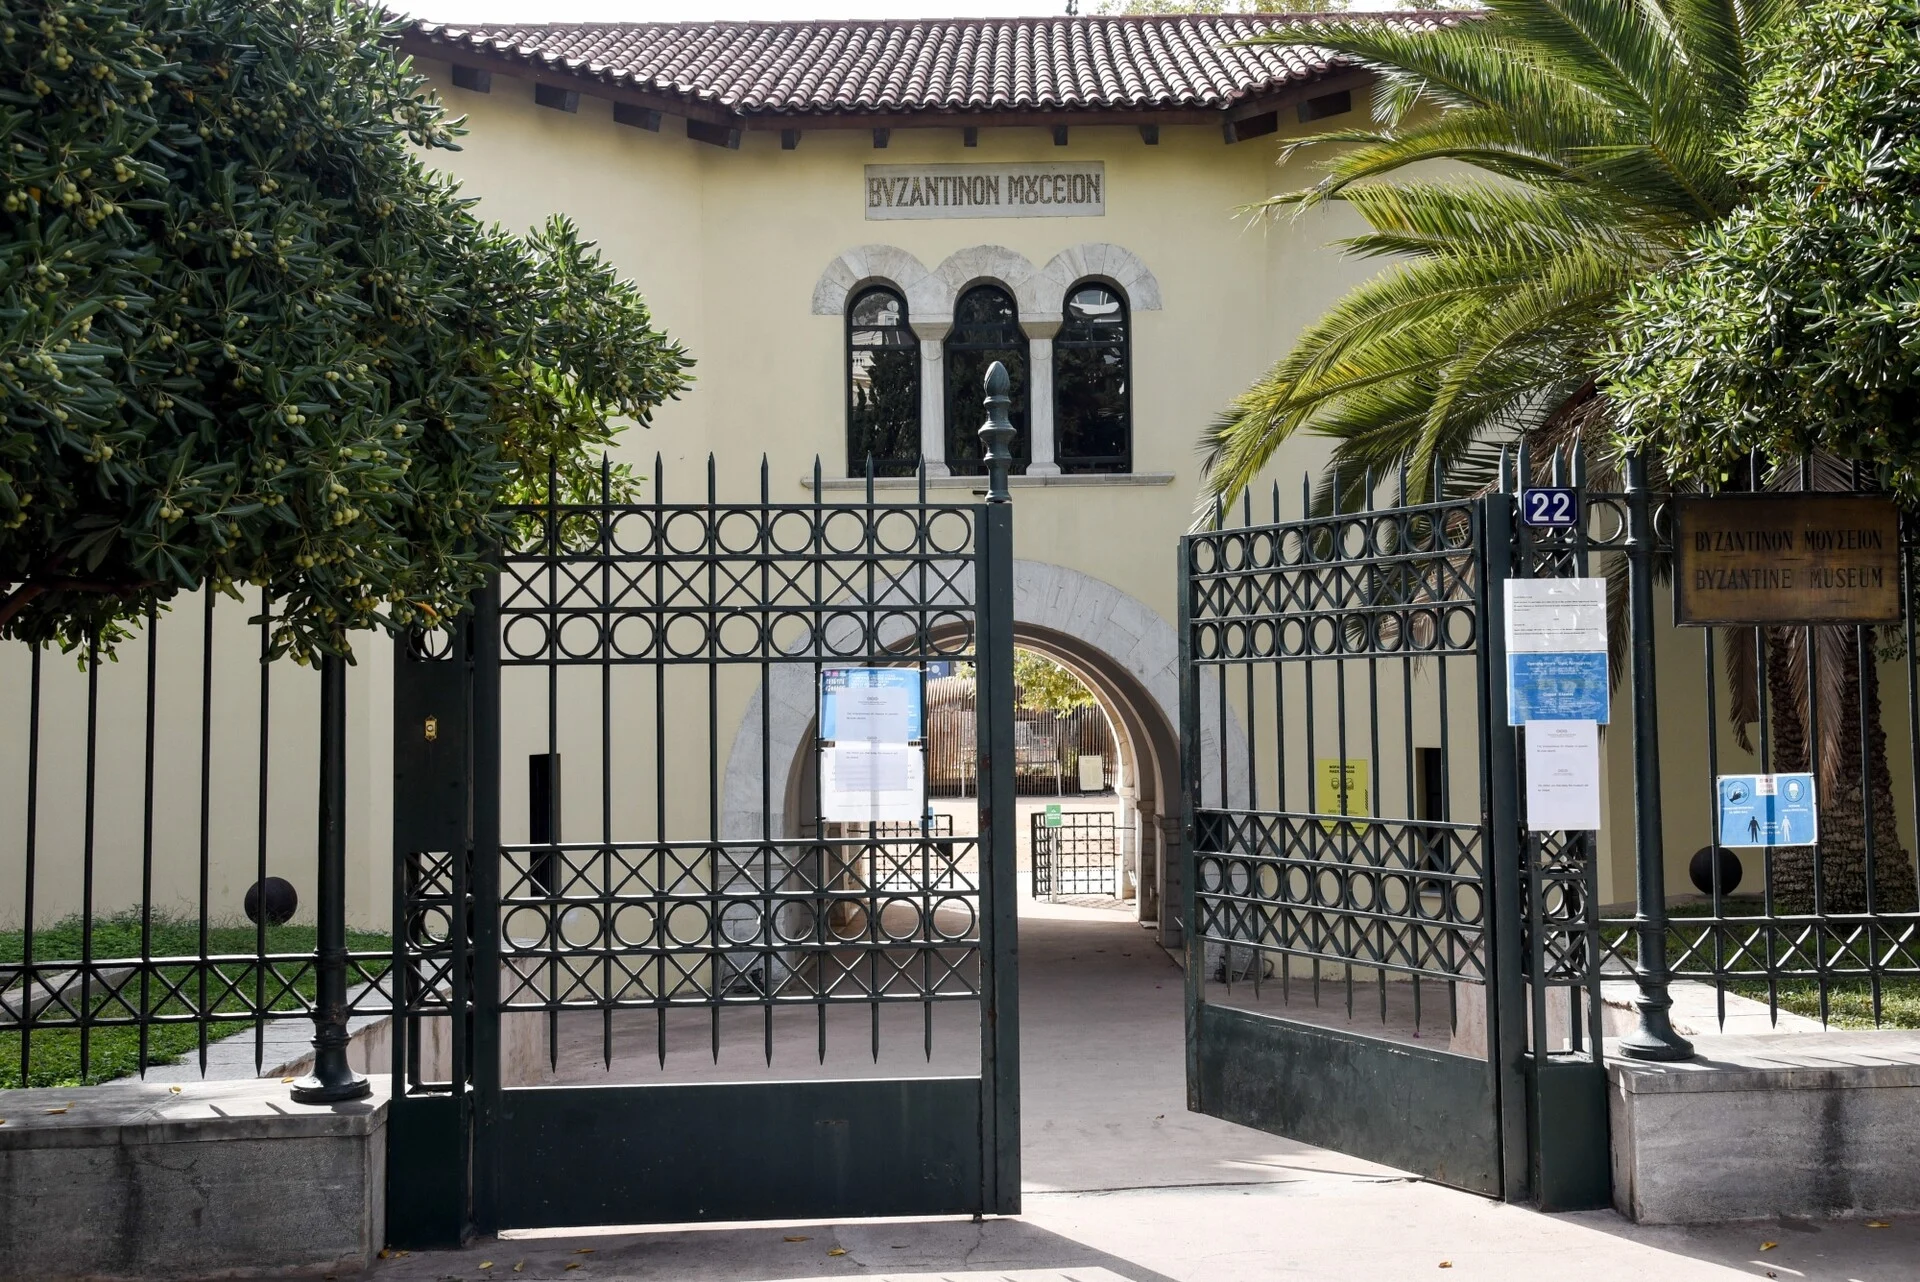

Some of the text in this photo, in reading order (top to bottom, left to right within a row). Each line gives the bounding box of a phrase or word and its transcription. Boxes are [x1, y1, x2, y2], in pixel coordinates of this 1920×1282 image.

[1532, 492, 1570, 522] 22
[1695, 530, 1882, 552] ΒΥΖΑΝΤΙΝΟΝ ΜΟΥΣΕΙΟΝ
[1695, 567, 1883, 590] BYZANTINE MUSEUM
